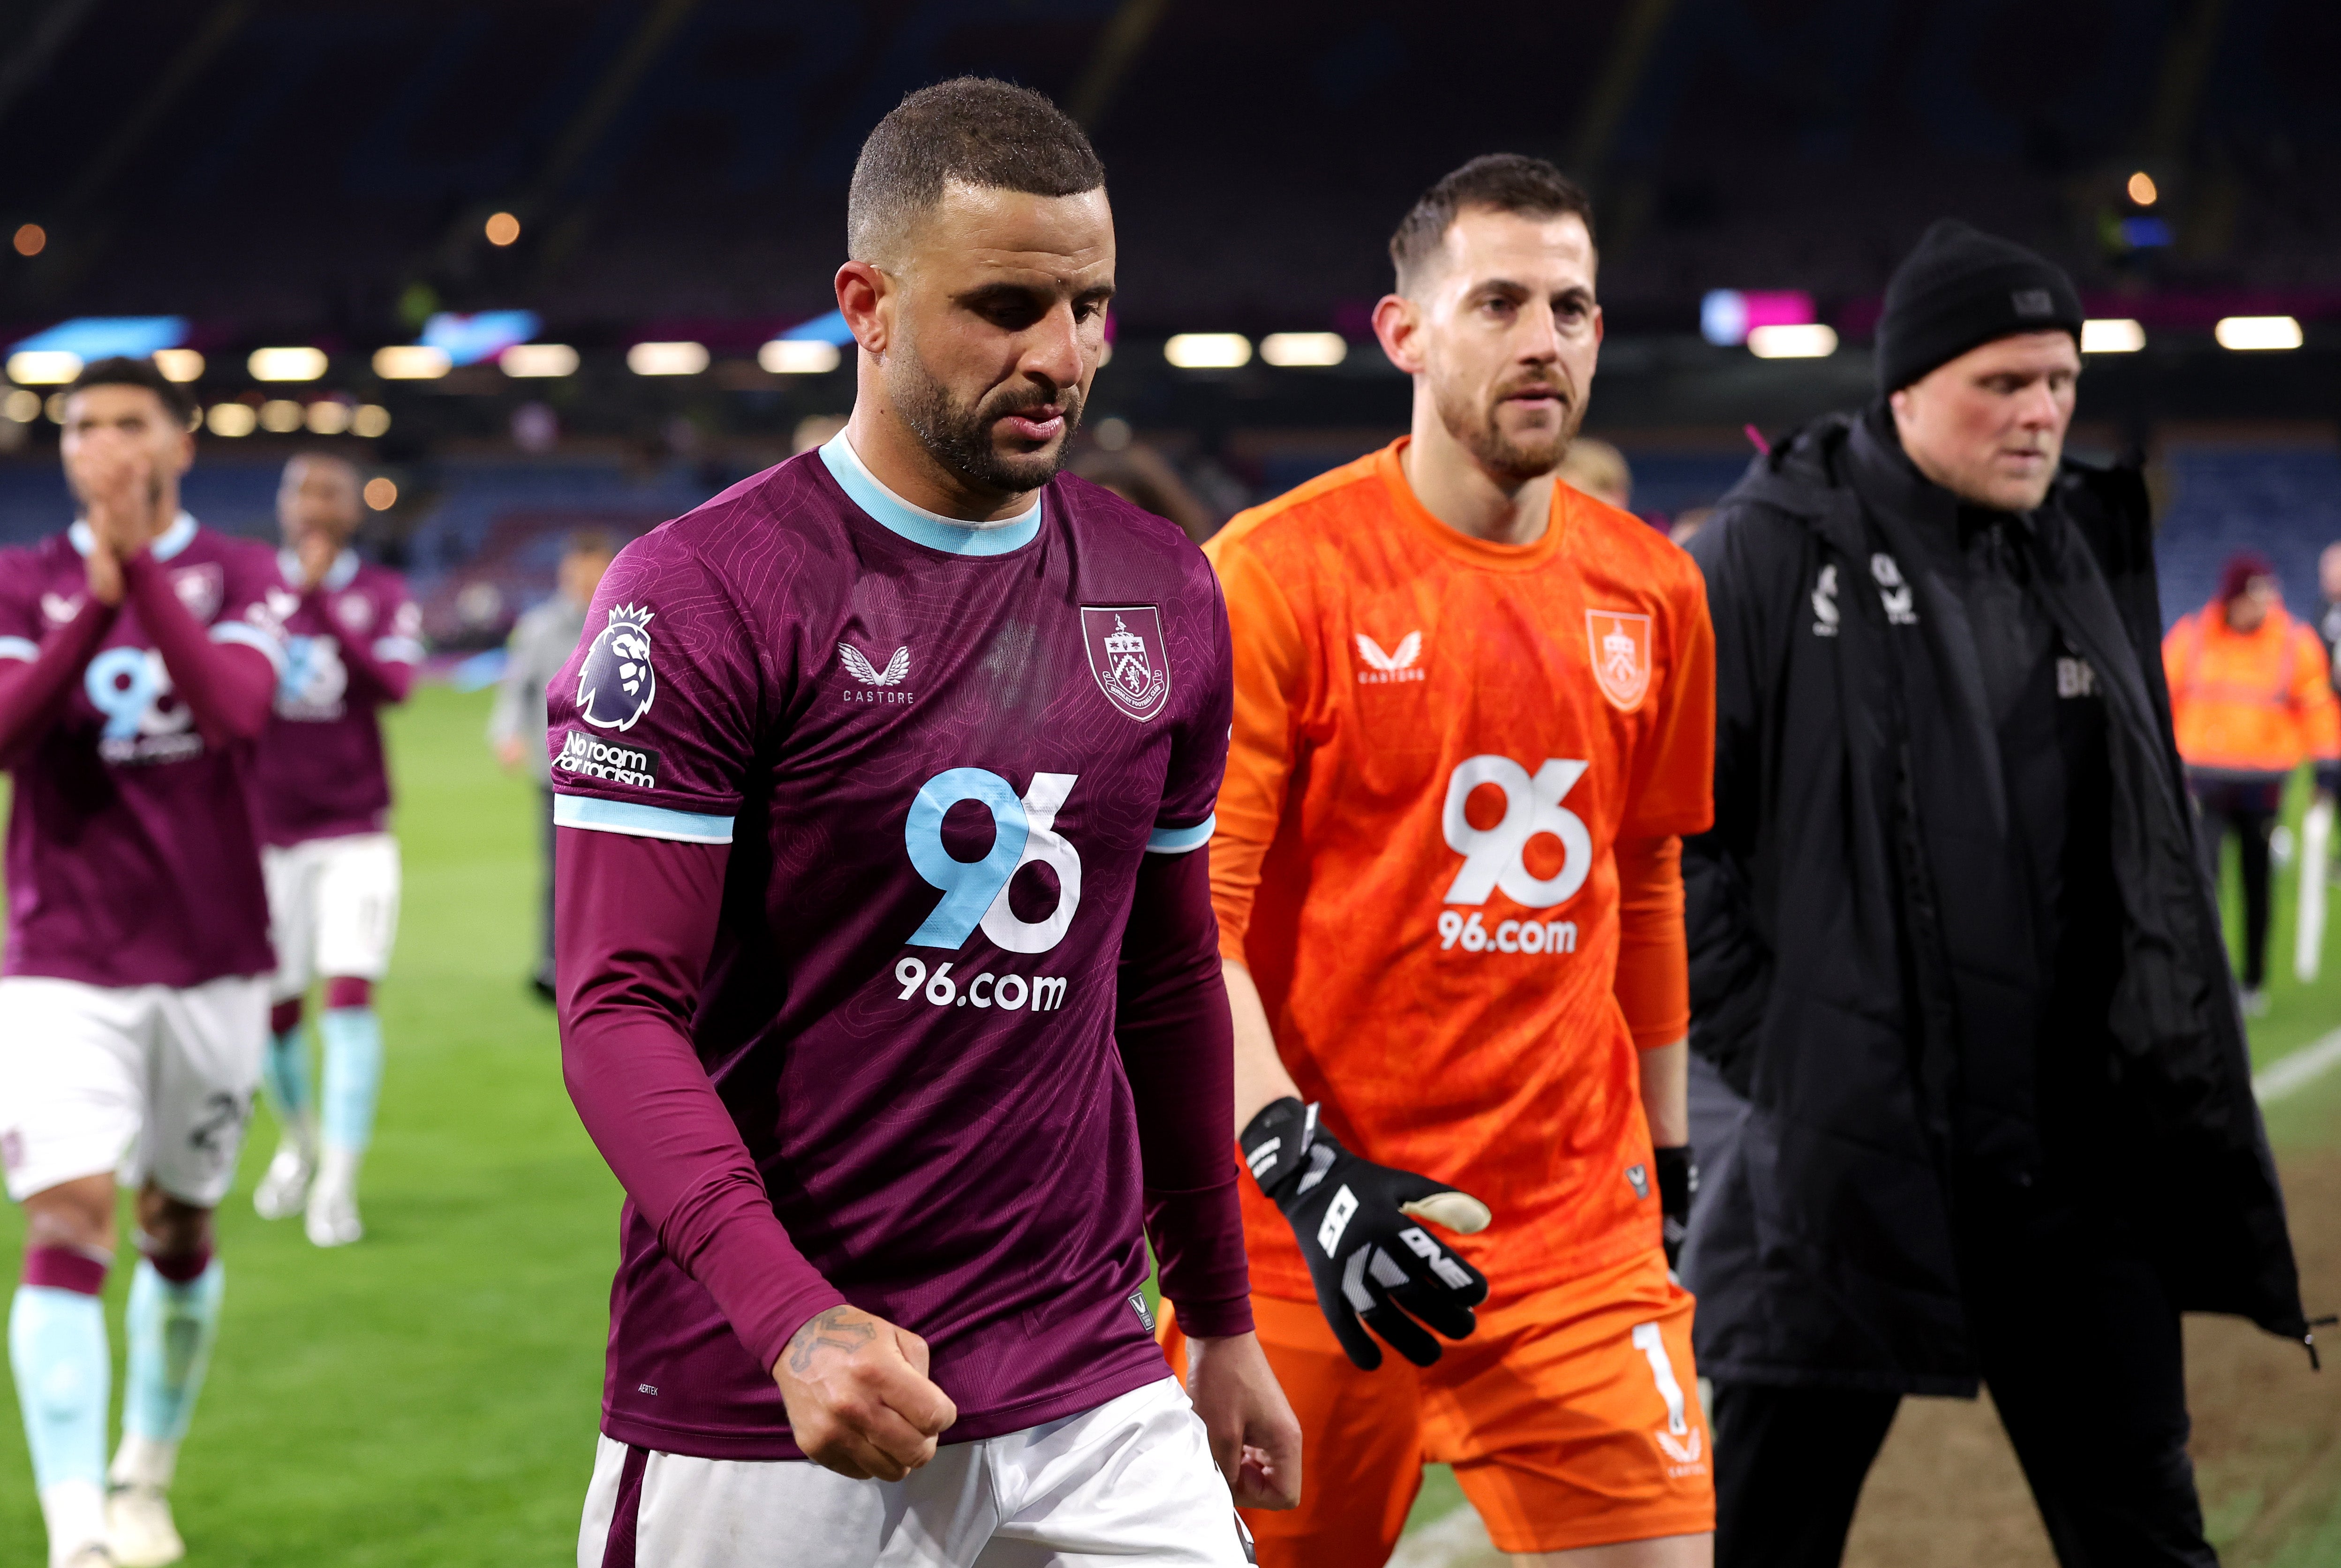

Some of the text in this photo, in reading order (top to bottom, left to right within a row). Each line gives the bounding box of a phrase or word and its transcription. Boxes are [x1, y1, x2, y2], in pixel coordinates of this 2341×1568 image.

[843, 690, 914, 704] CASTORE
[1110, 685, 1161, 707] BURNLEY FOOTBALL CLUB
[563, 731, 647, 771] No room
[581, 760, 655, 789] racism
[1442, 754, 1593, 908] 96
[905, 767, 1082, 954] 96
[1438, 910, 1578, 954] 96.com
[895, 957, 1067, 1012] 96.com
[638, 1383, 658, 1396] AERTEK
[1632, 1321, 1688, 1436] 1
